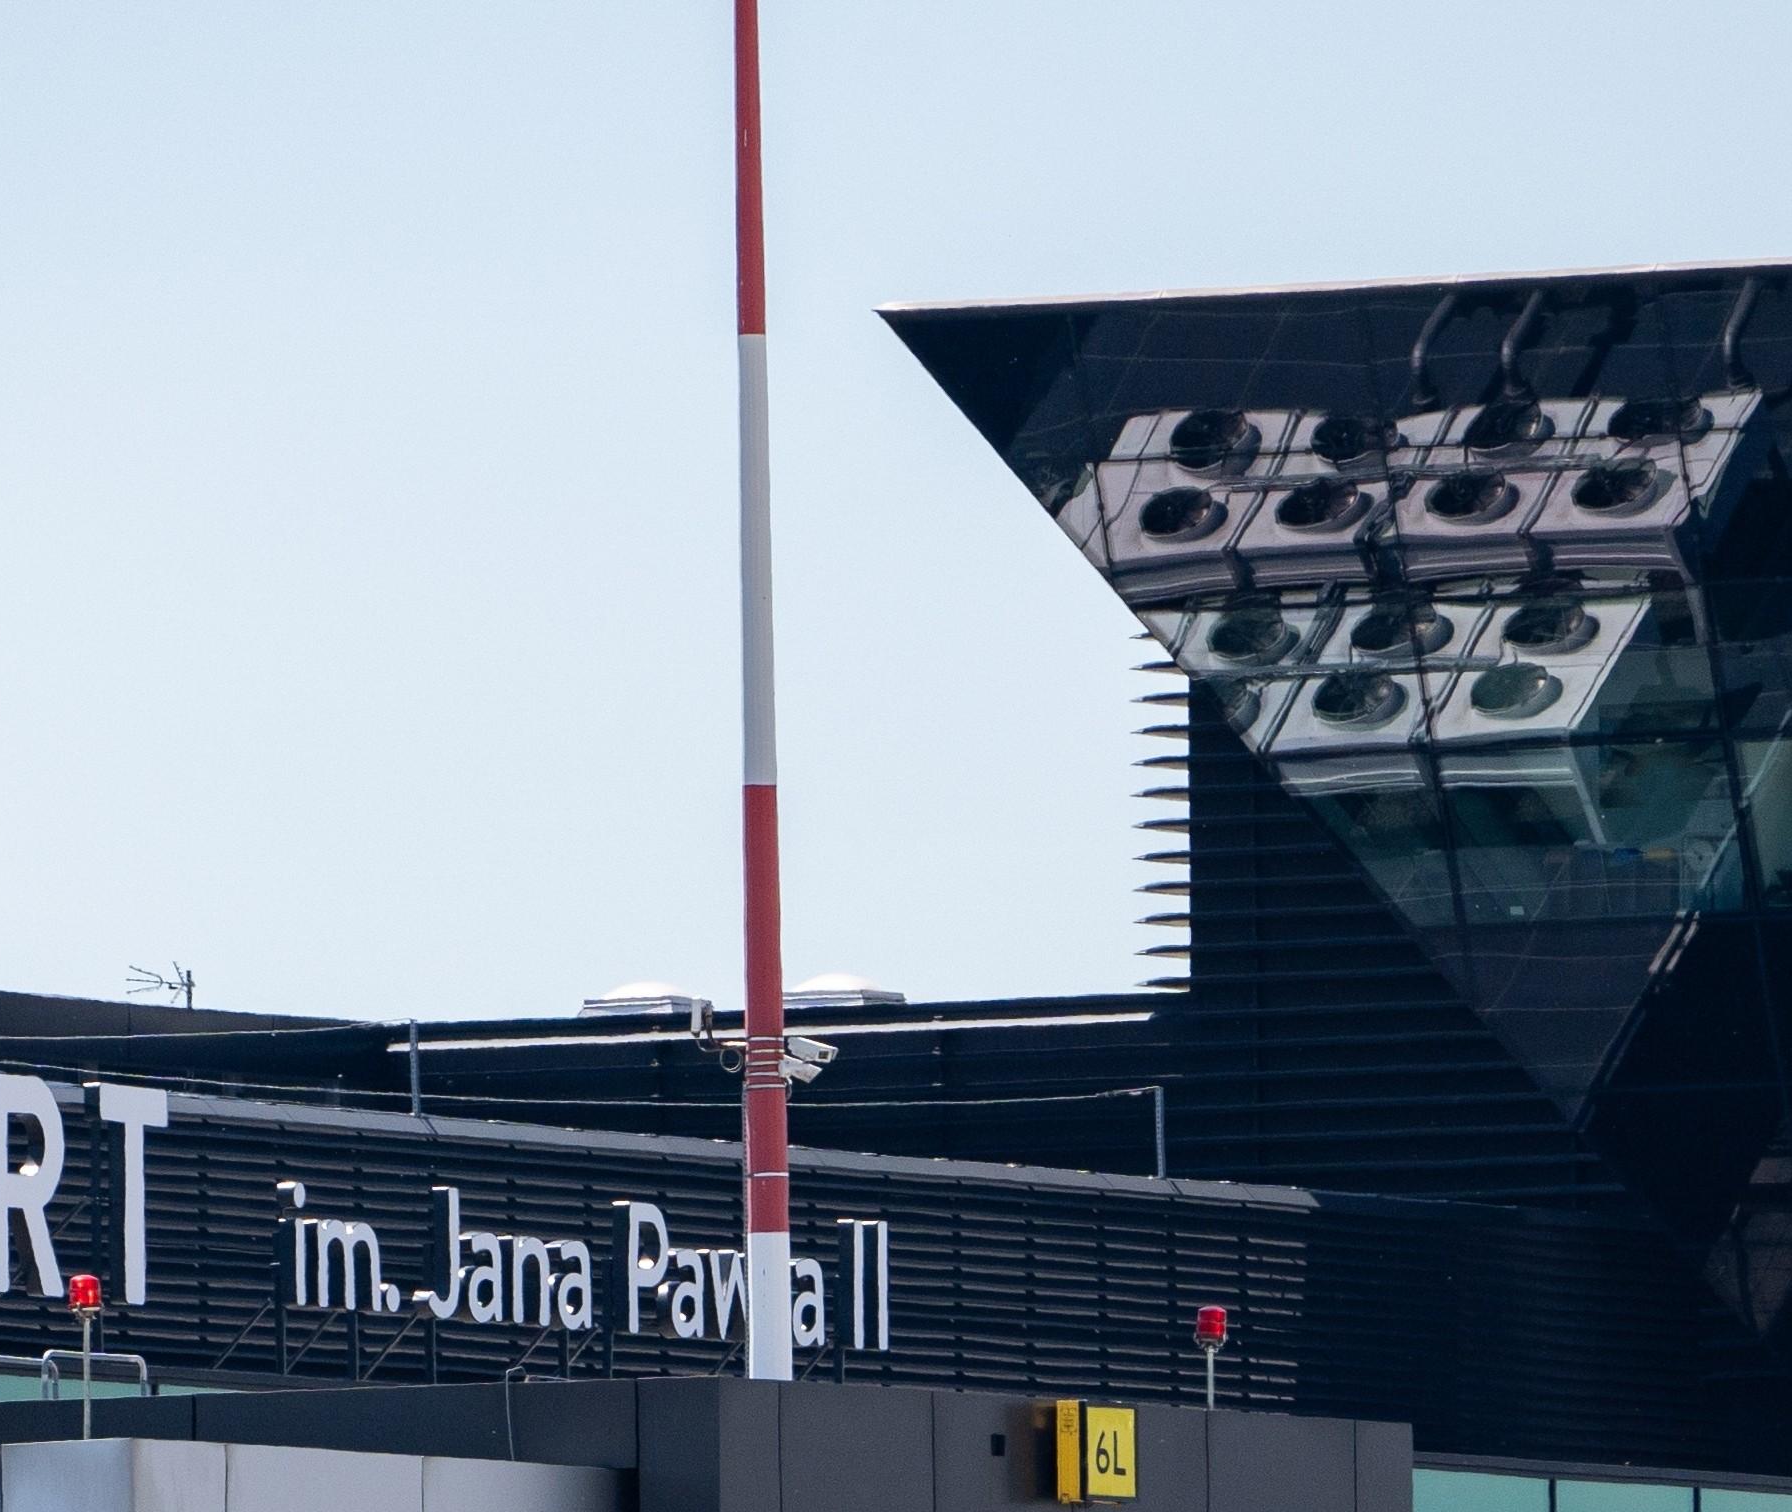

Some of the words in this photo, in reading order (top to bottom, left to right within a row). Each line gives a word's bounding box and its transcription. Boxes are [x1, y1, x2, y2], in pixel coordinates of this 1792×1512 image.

[277, 1181, 400, 1313] im.
[413, 1186, 593, 1331] Jana
[613, 1200, 826, 1348] Pawa
[1095, 1430, 1127, 1476] 6L
